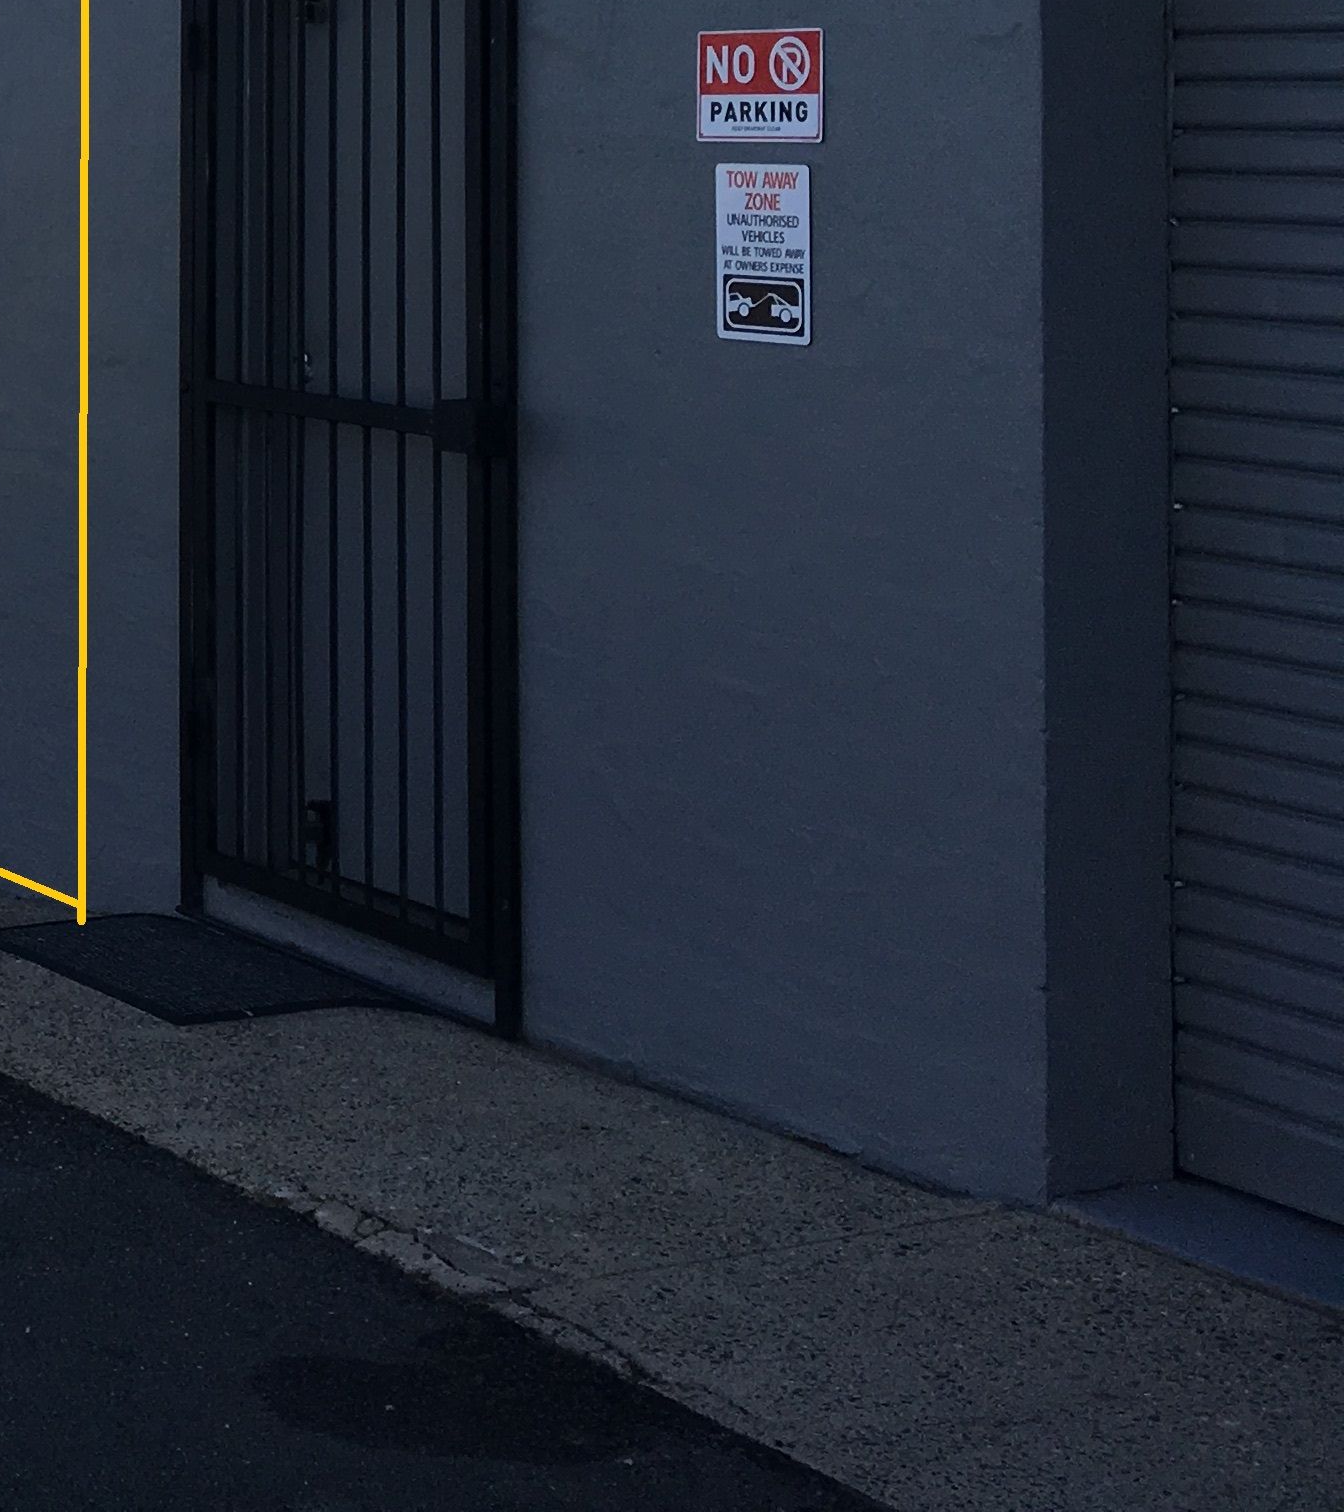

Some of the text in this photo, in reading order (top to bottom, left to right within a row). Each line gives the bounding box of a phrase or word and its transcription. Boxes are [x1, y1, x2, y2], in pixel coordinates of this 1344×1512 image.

[706, 44, 755, 84] NO
[710, 101, 808, 123] PARKING
[726, 170, 799, 189] TOW AWAY
[745, 192, 781, 211] ZONE
[727, 213, 800, 228] UNAUTHORISED
[742, 230, 785, 244] VEHICLES
[754, 246, 782, 258] TOWED
